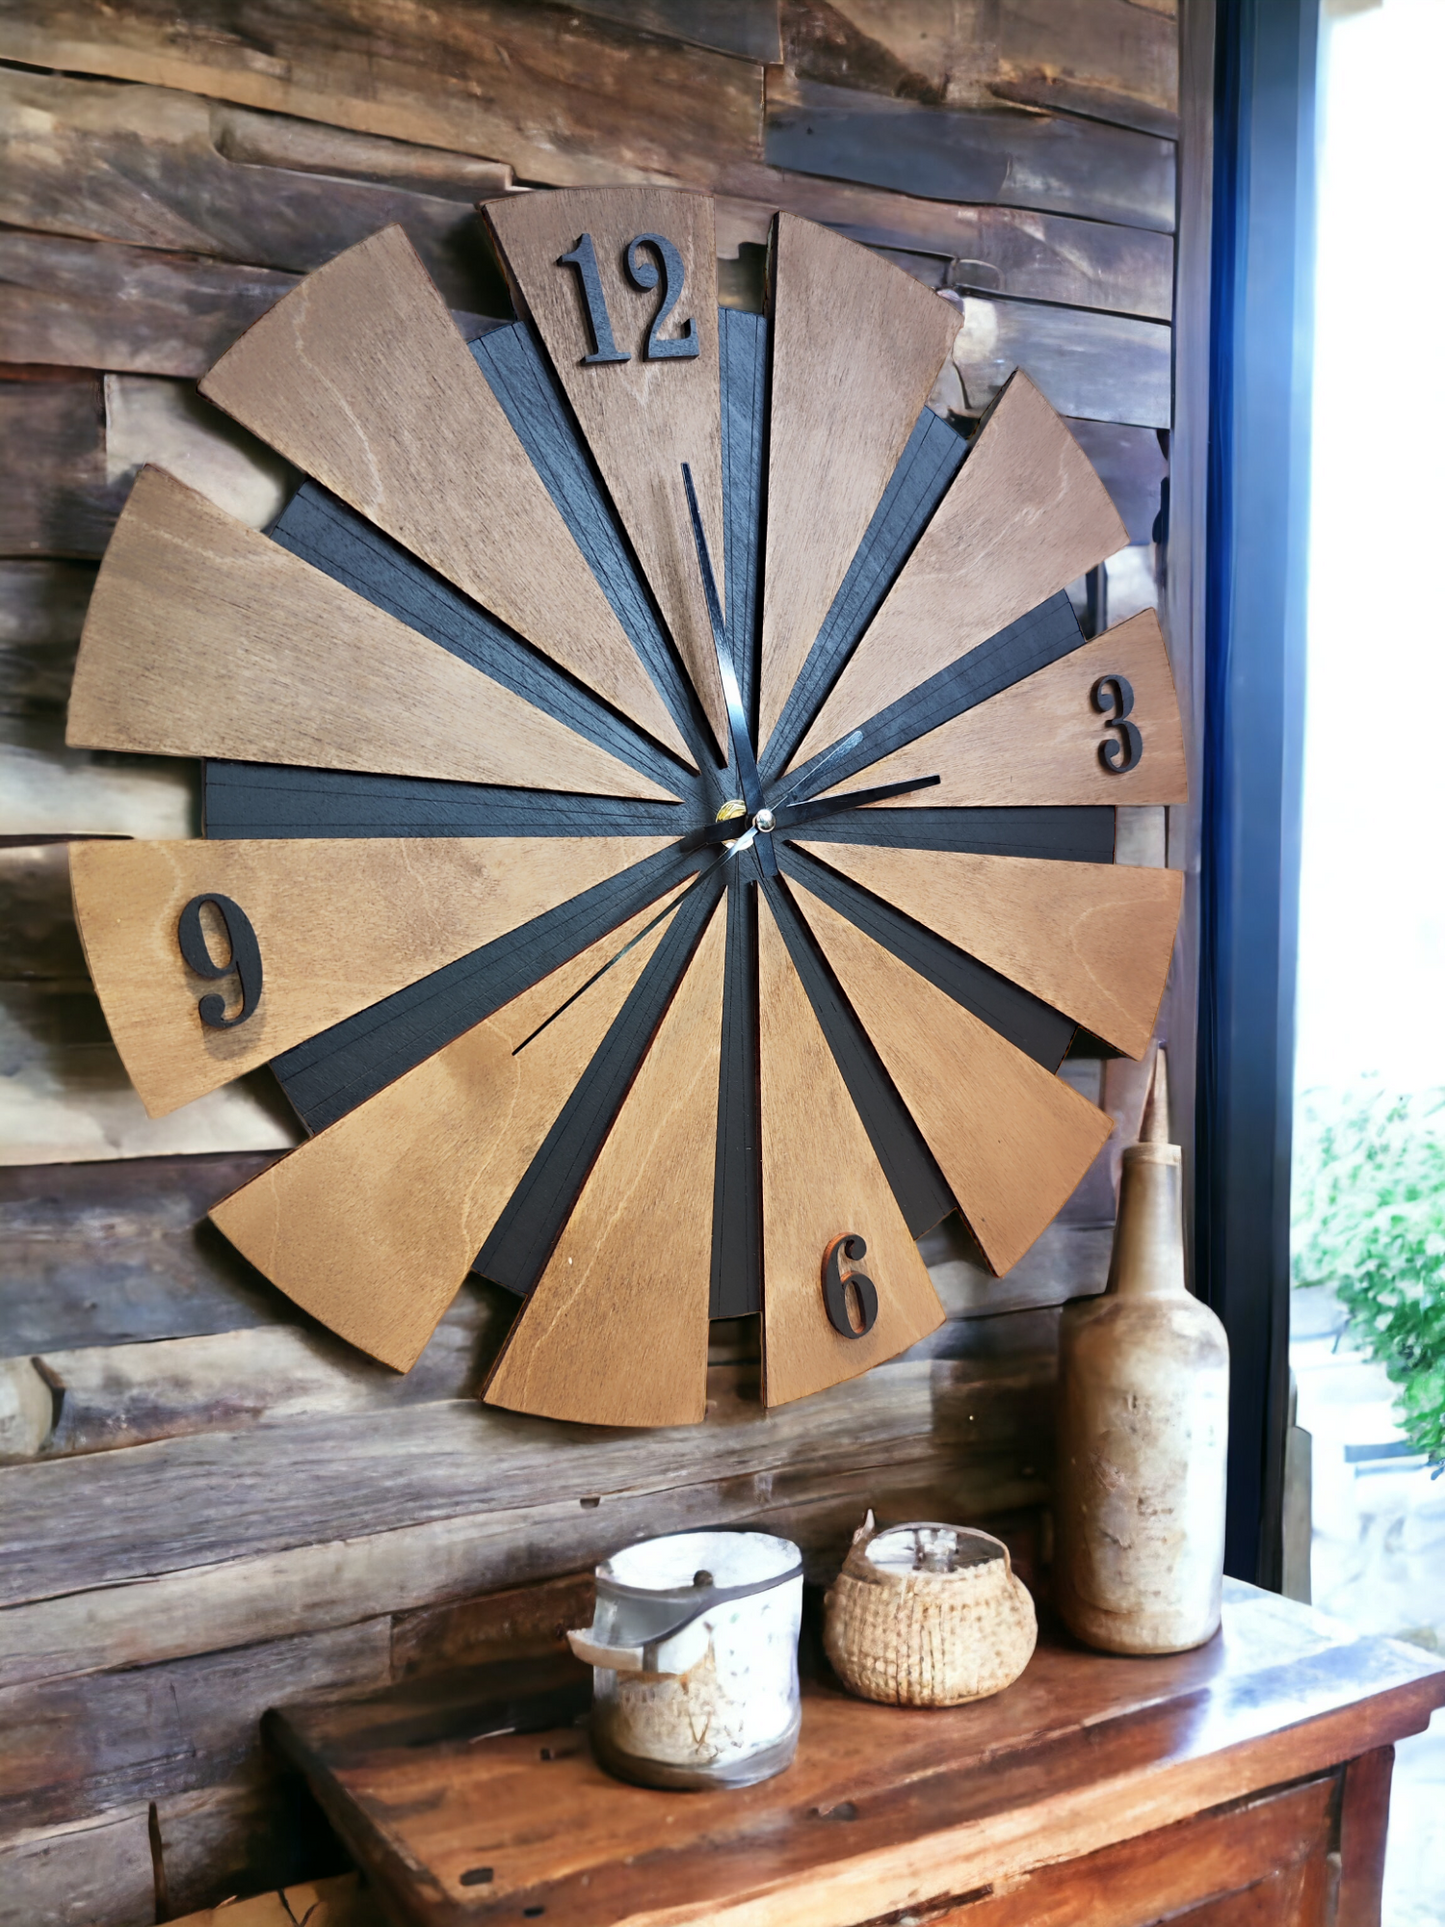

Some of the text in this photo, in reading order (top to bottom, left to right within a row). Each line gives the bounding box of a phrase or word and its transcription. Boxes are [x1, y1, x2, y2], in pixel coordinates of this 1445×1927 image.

[556, 232, 700, 366] 12
[1089, 674, 1144, 775] 3
[178, 892, 263, 1029] 9
[820, 1232, 879, 1340] 6
